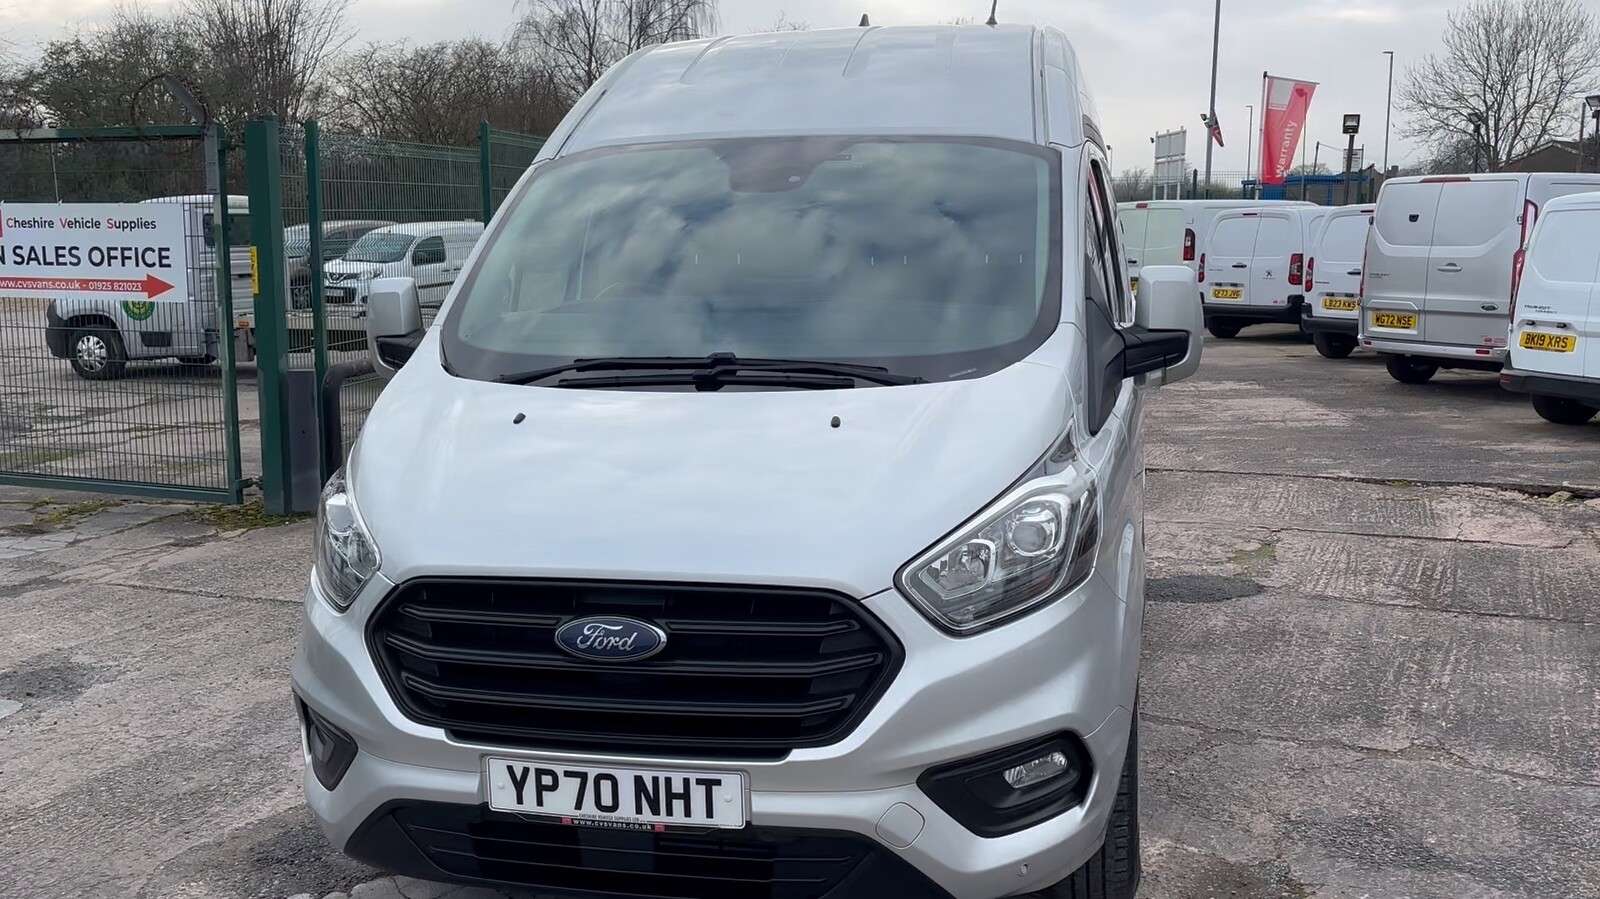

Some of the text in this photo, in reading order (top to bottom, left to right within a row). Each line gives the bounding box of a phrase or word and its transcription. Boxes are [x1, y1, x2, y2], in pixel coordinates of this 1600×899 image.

[1275, 120, 1298, 178] Warranty
[6, 217, 157, 232] Cheshire Vehicle Supplies
[12, 245, 82, 267] SALES
[87, 247, 172, 269] OFFICE
[88, 282, 112, 291] 01925
[113, 282, 143, 291] 821023
[1375, 313, 1413, 327] WG72 NSE
[1525, 333, 1569, 349] BK19 XRS
[577, 623, 638, 651] Ford
[506, 764, 722, 820] YP70 NHT
[573, 818, 652, 830] www.cvsvans.co.uk
